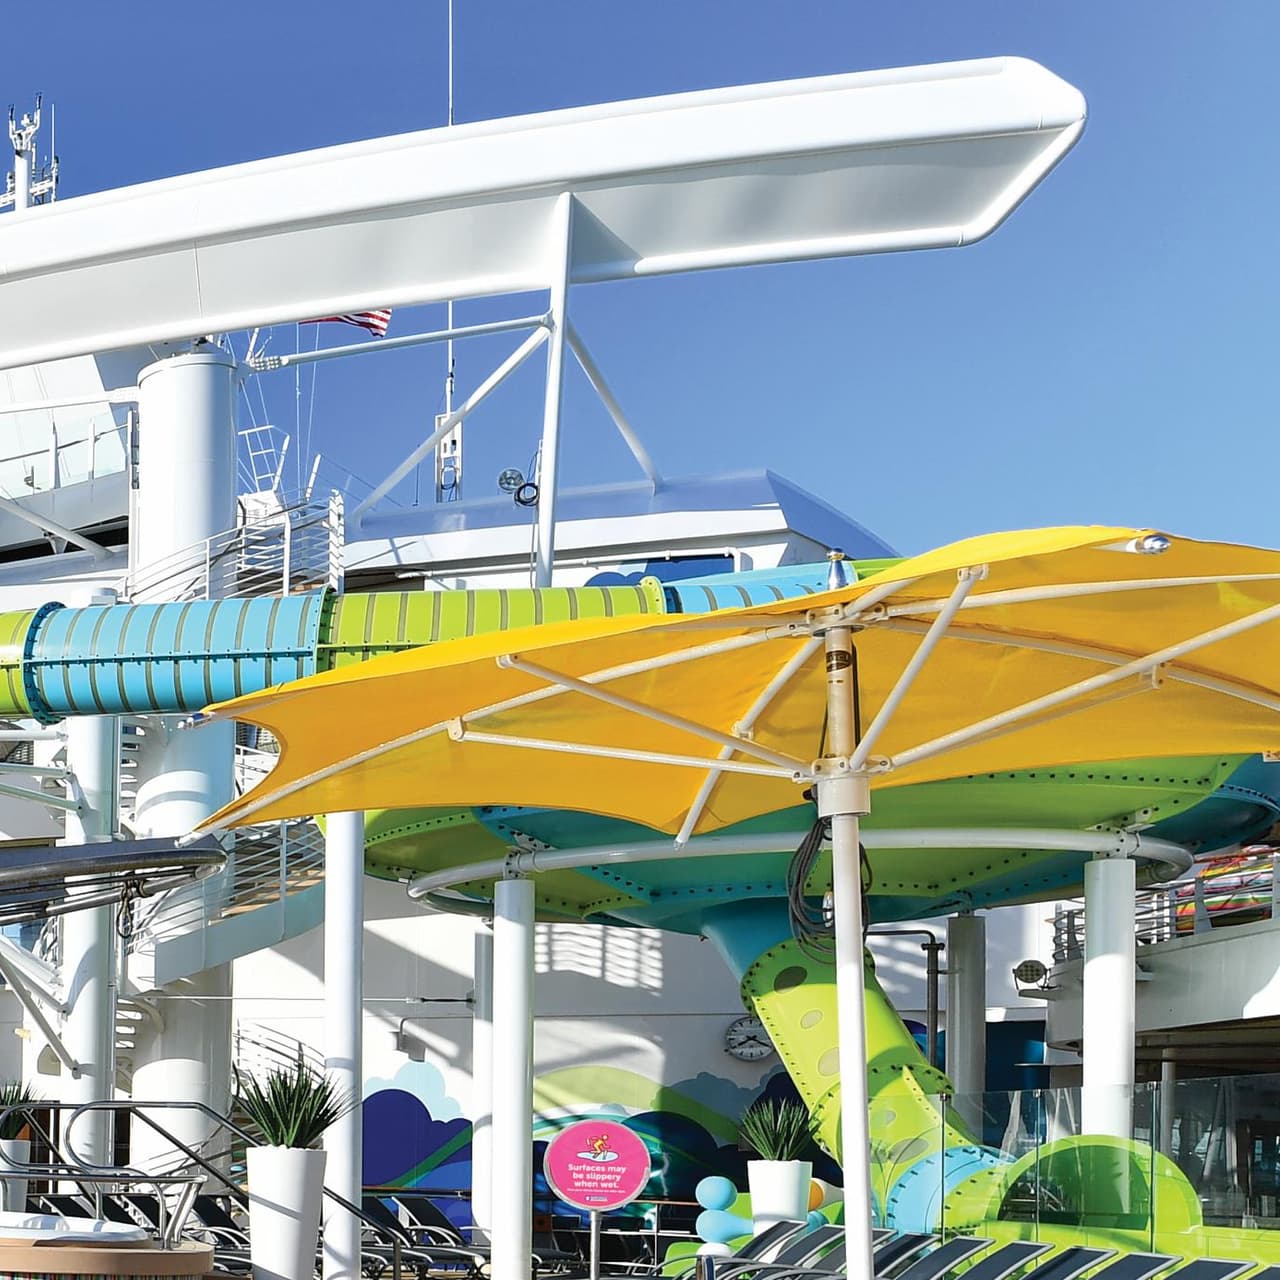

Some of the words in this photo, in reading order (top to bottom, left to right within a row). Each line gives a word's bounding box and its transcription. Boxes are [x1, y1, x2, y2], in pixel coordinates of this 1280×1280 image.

[567, 1163, 605, 1171] Surfaces
[608, 1166, 626, 1174] may
[586, 1172, 621, 1181] slippery
[574, 1180, 598, 1188] when
[600, 1181, 619, 1189] wet.
